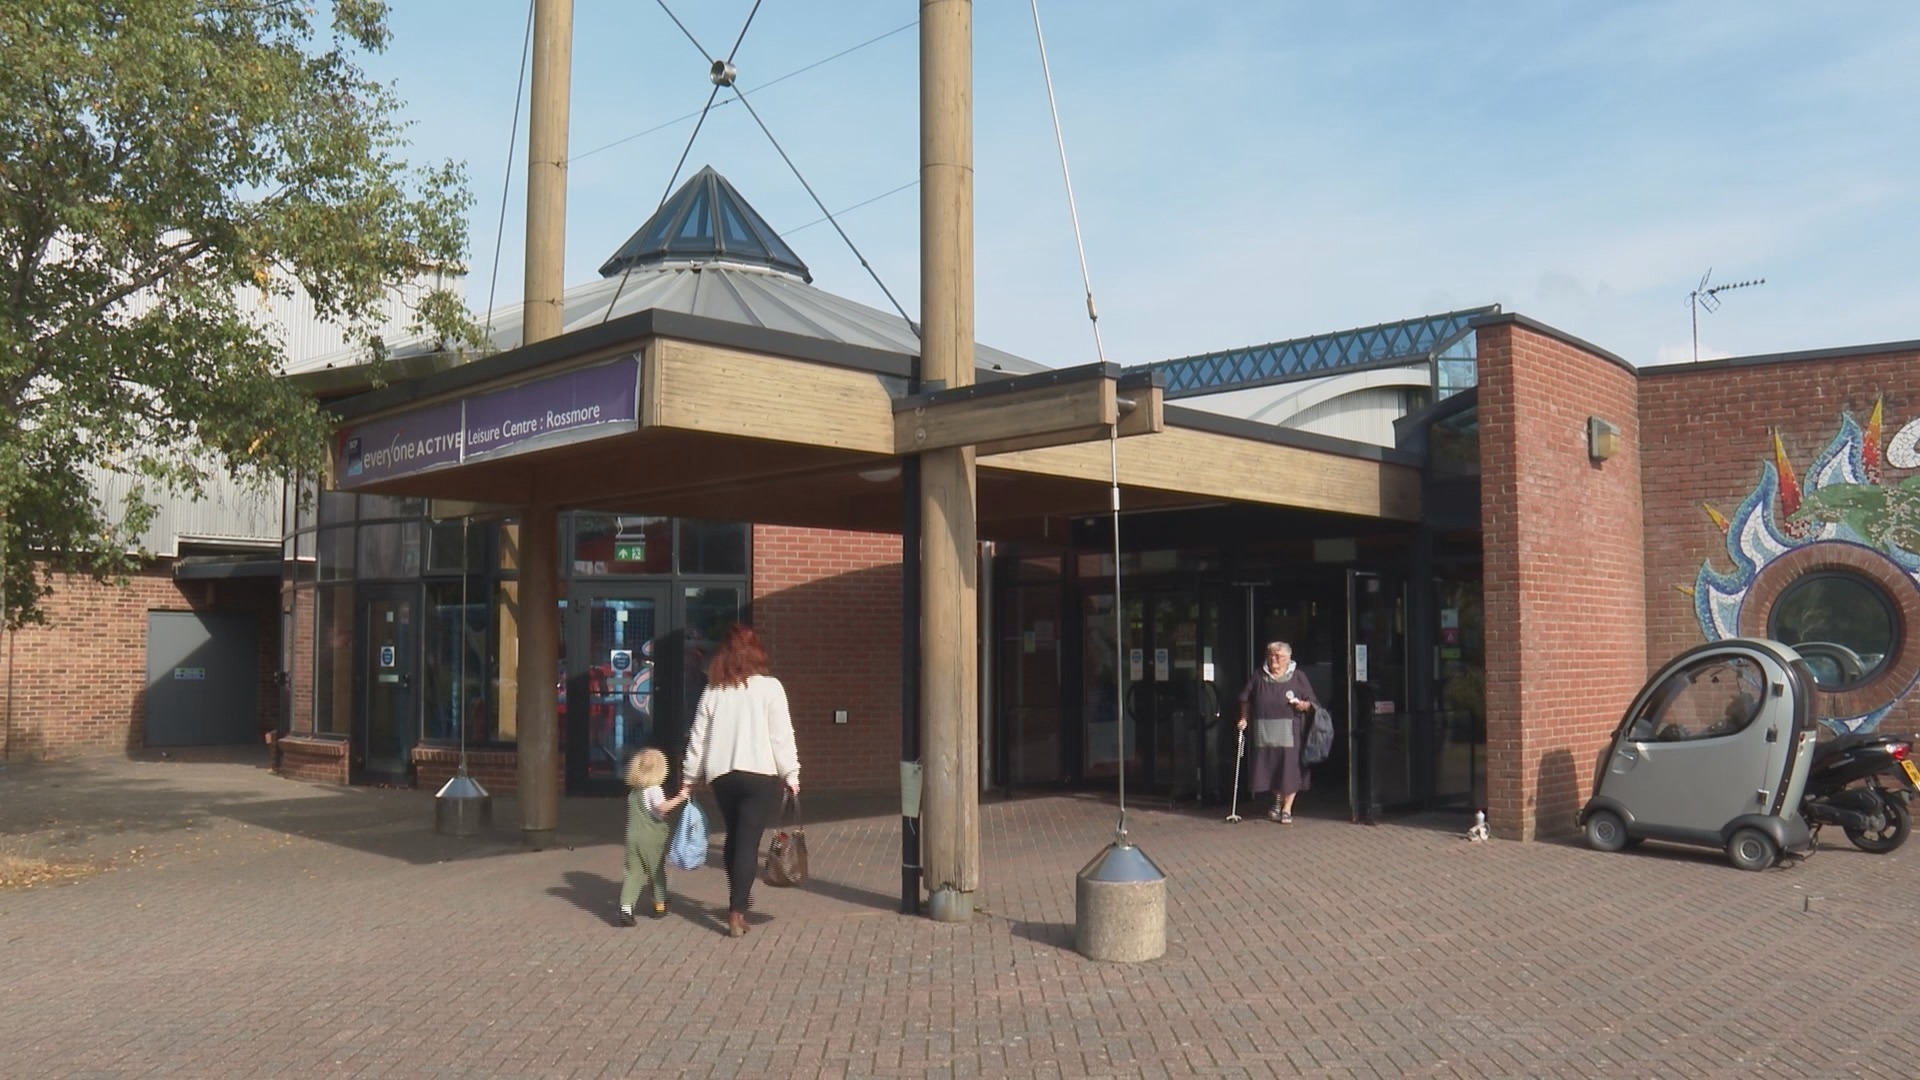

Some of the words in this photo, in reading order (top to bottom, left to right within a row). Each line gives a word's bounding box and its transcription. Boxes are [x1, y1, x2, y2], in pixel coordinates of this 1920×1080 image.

[467, 428, 500, 446] Leisure
[502, 420, 537, 438] Centre
[546, 405, 600, 429] Rossmore
[363, 433, 415, 469] everyone
[416, 432, 461, 457] ACTIVE
